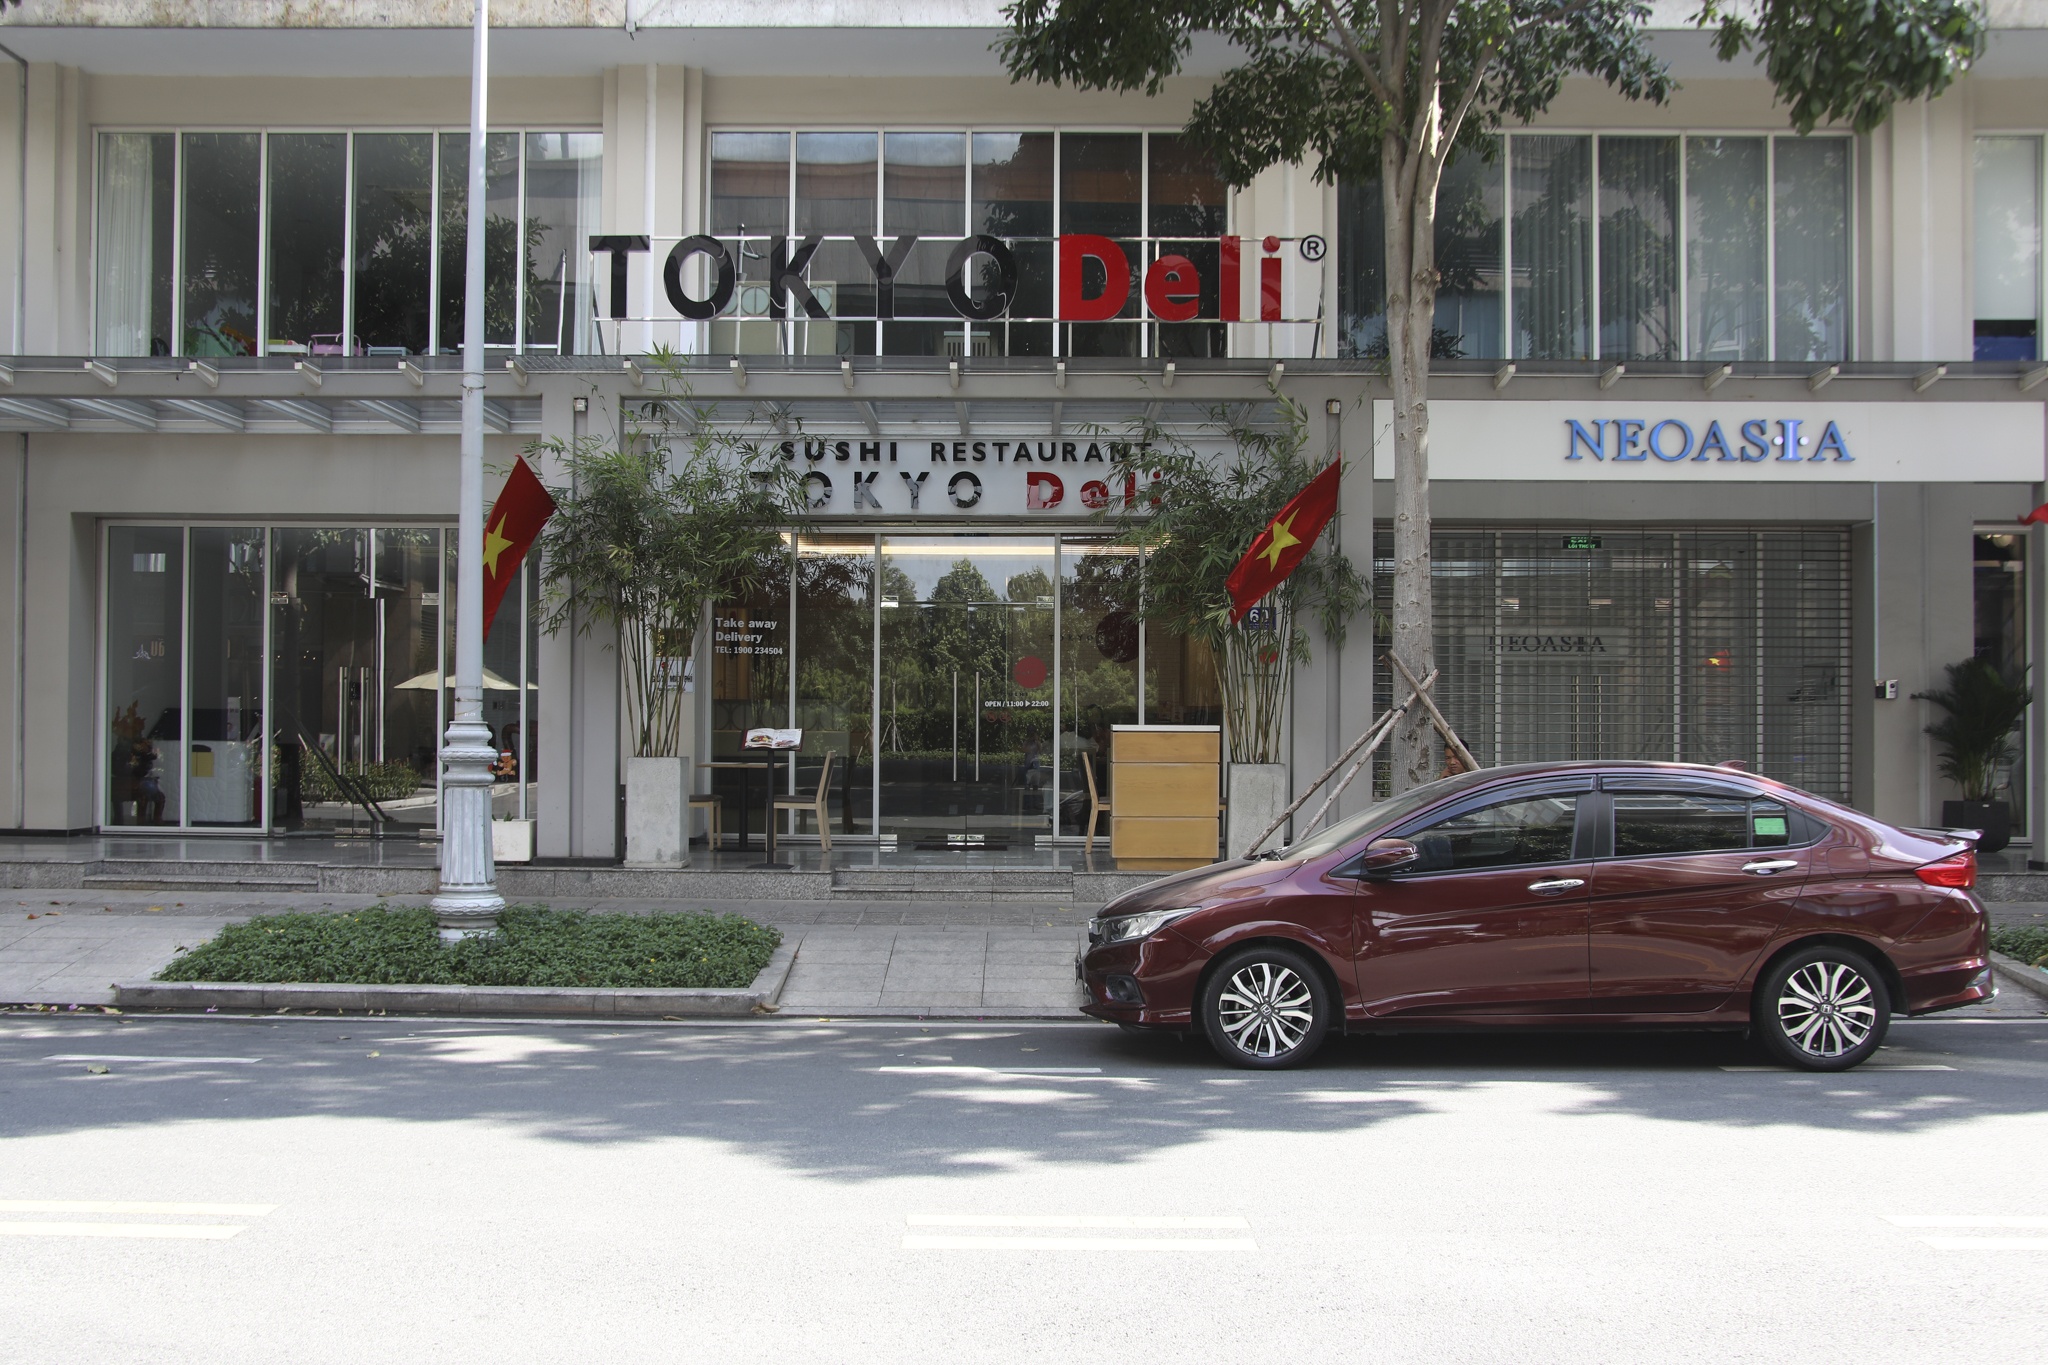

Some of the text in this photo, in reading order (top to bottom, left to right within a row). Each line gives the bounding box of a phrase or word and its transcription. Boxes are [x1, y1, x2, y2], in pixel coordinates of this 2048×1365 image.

[589, 235, 1018, 320] TOKYO
[1059, 234, 1282, 322] Deli
[1564, 419, 1856, 462] NEOASIA
[780, 441, 1152, 462] SUSHI RESTAURANT
[715, 617, 777, 630] Take away
[715, 631, 763, 643] Delivery
[1487, 636, 1607, 653] NEOASIA
[715, 645, 783, 655] TEL: 1900 234504
